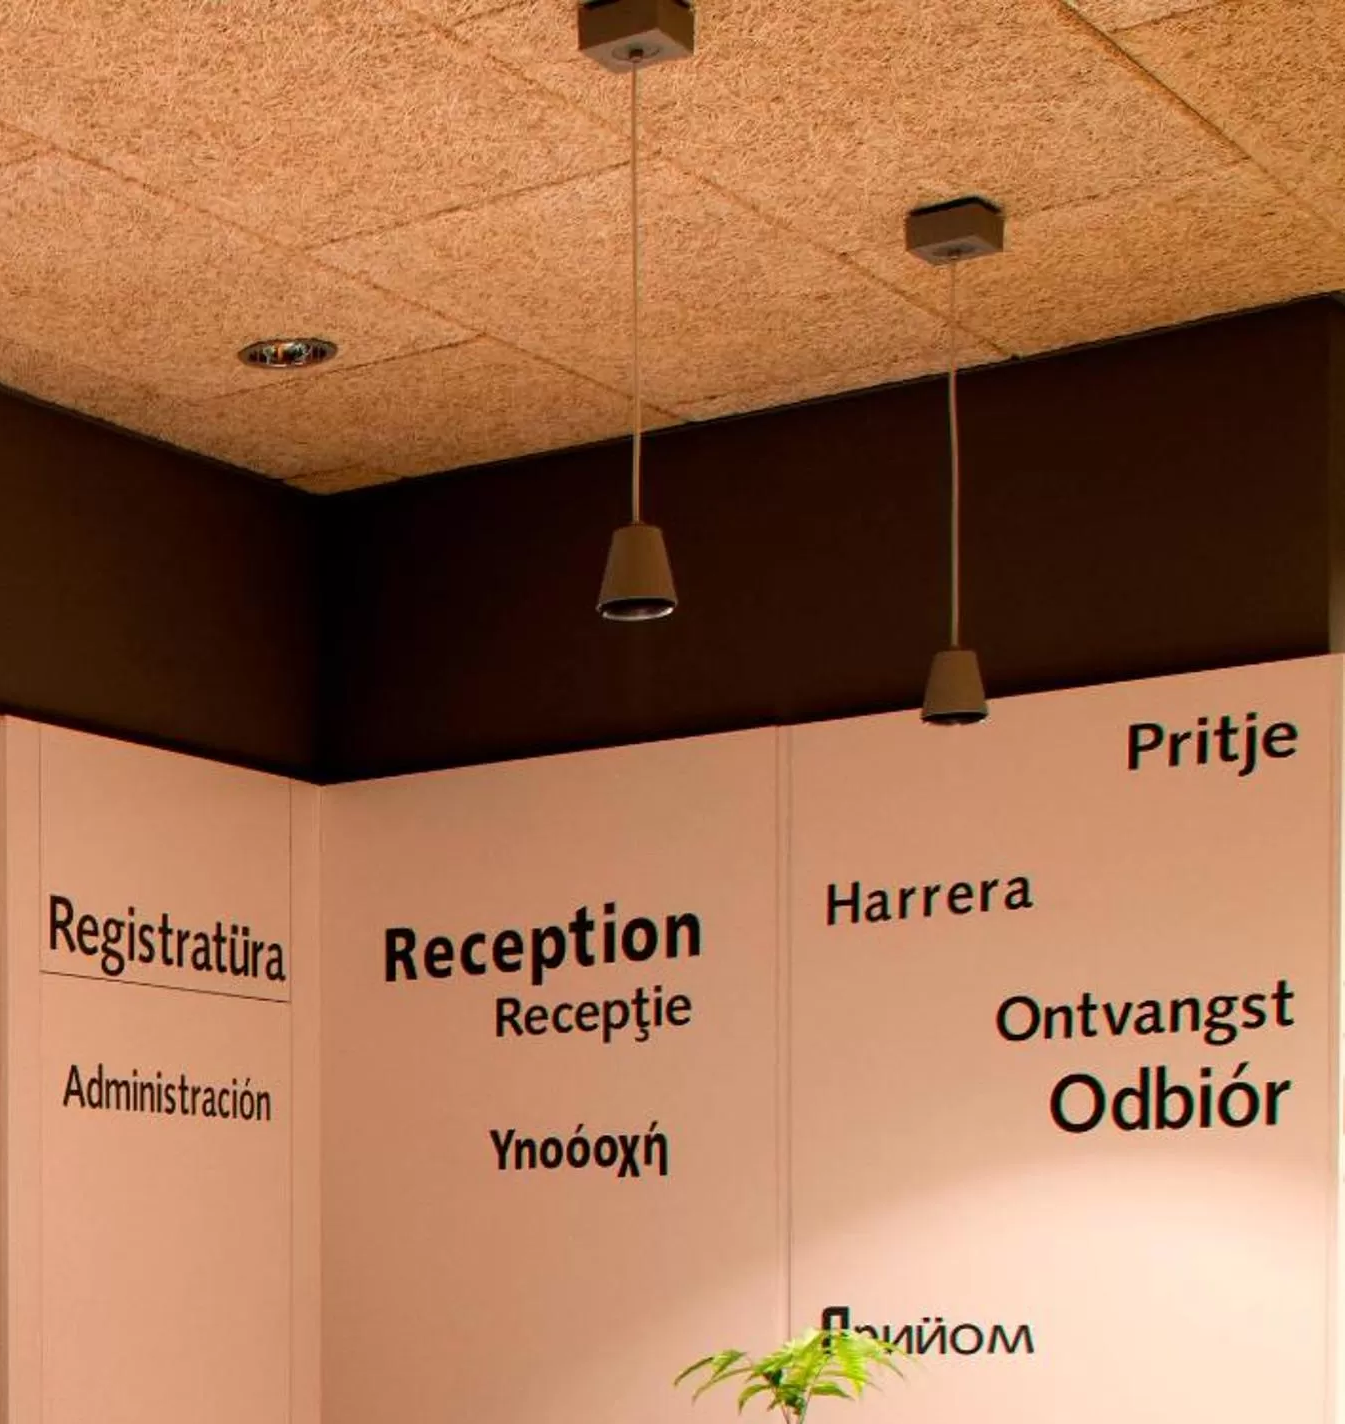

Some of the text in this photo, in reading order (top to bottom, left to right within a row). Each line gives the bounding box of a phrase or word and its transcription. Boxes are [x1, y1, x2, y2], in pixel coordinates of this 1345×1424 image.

[1127, 711, 1298, 777] Pritje
[826, 876, 1034, 927] Harrera
[48, 894, 287, 981] Registratüra
[384, 901, 701, 986] Reception
[995, 979, 1295, 1047] Ontvangst
[62, 1063, 271, 1122] Administración
[1049, 1061, 1291, 1134] Odbiór
